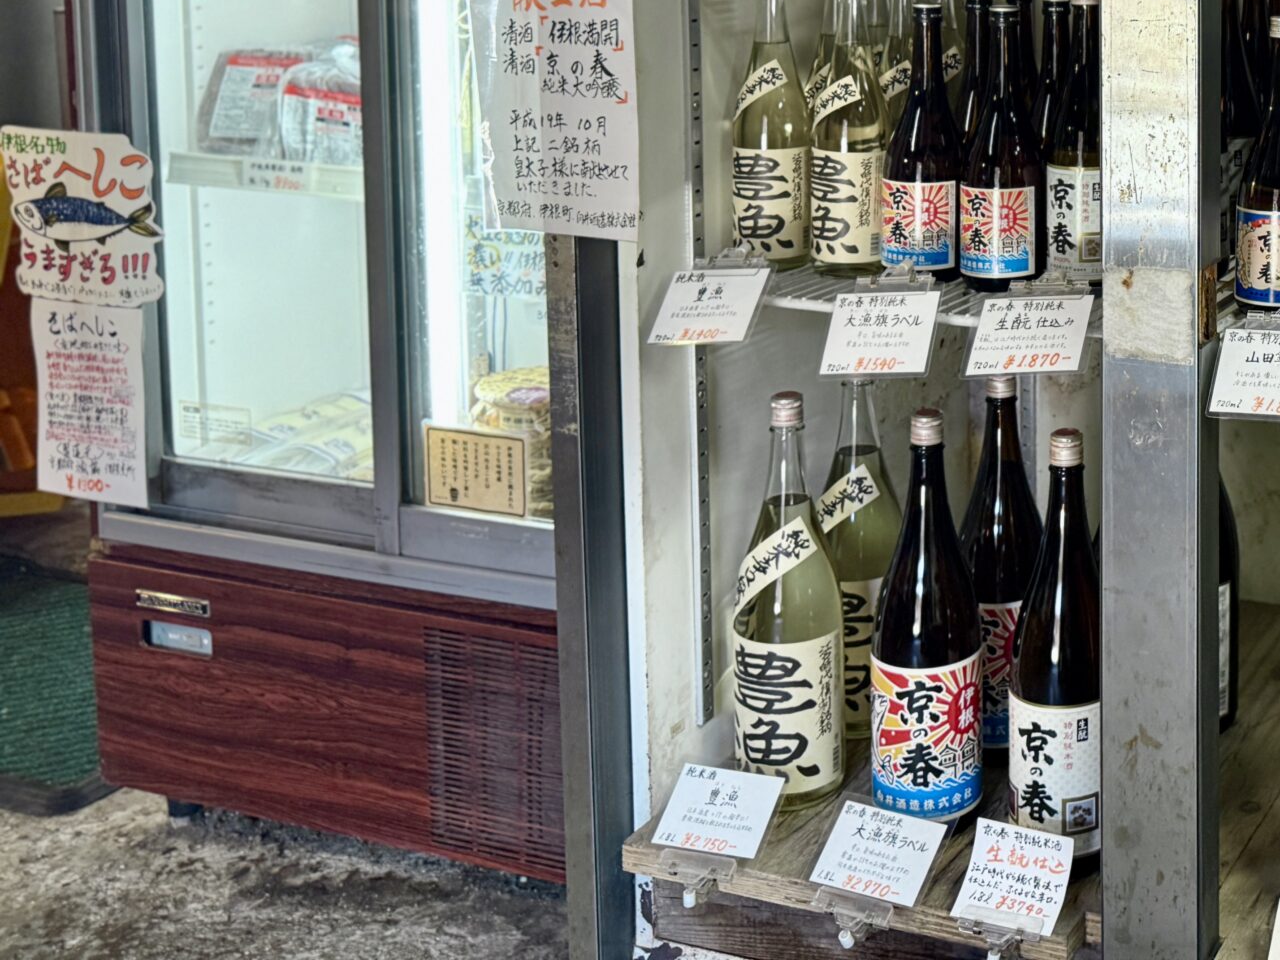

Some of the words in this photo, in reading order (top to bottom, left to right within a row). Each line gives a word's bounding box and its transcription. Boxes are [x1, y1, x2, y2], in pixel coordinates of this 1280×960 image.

[578, 116, 608, 136] 10月
[889, 187, 908, 245] 京の春
[967, 194, 988, 252] 京の春
[1049, 178, 1076, 255] 京の春
[895, 681, 945, 788] 京の春
[958, 689, 976, 730] 伊根
[1018, 722, 1059, 824] 京の春
